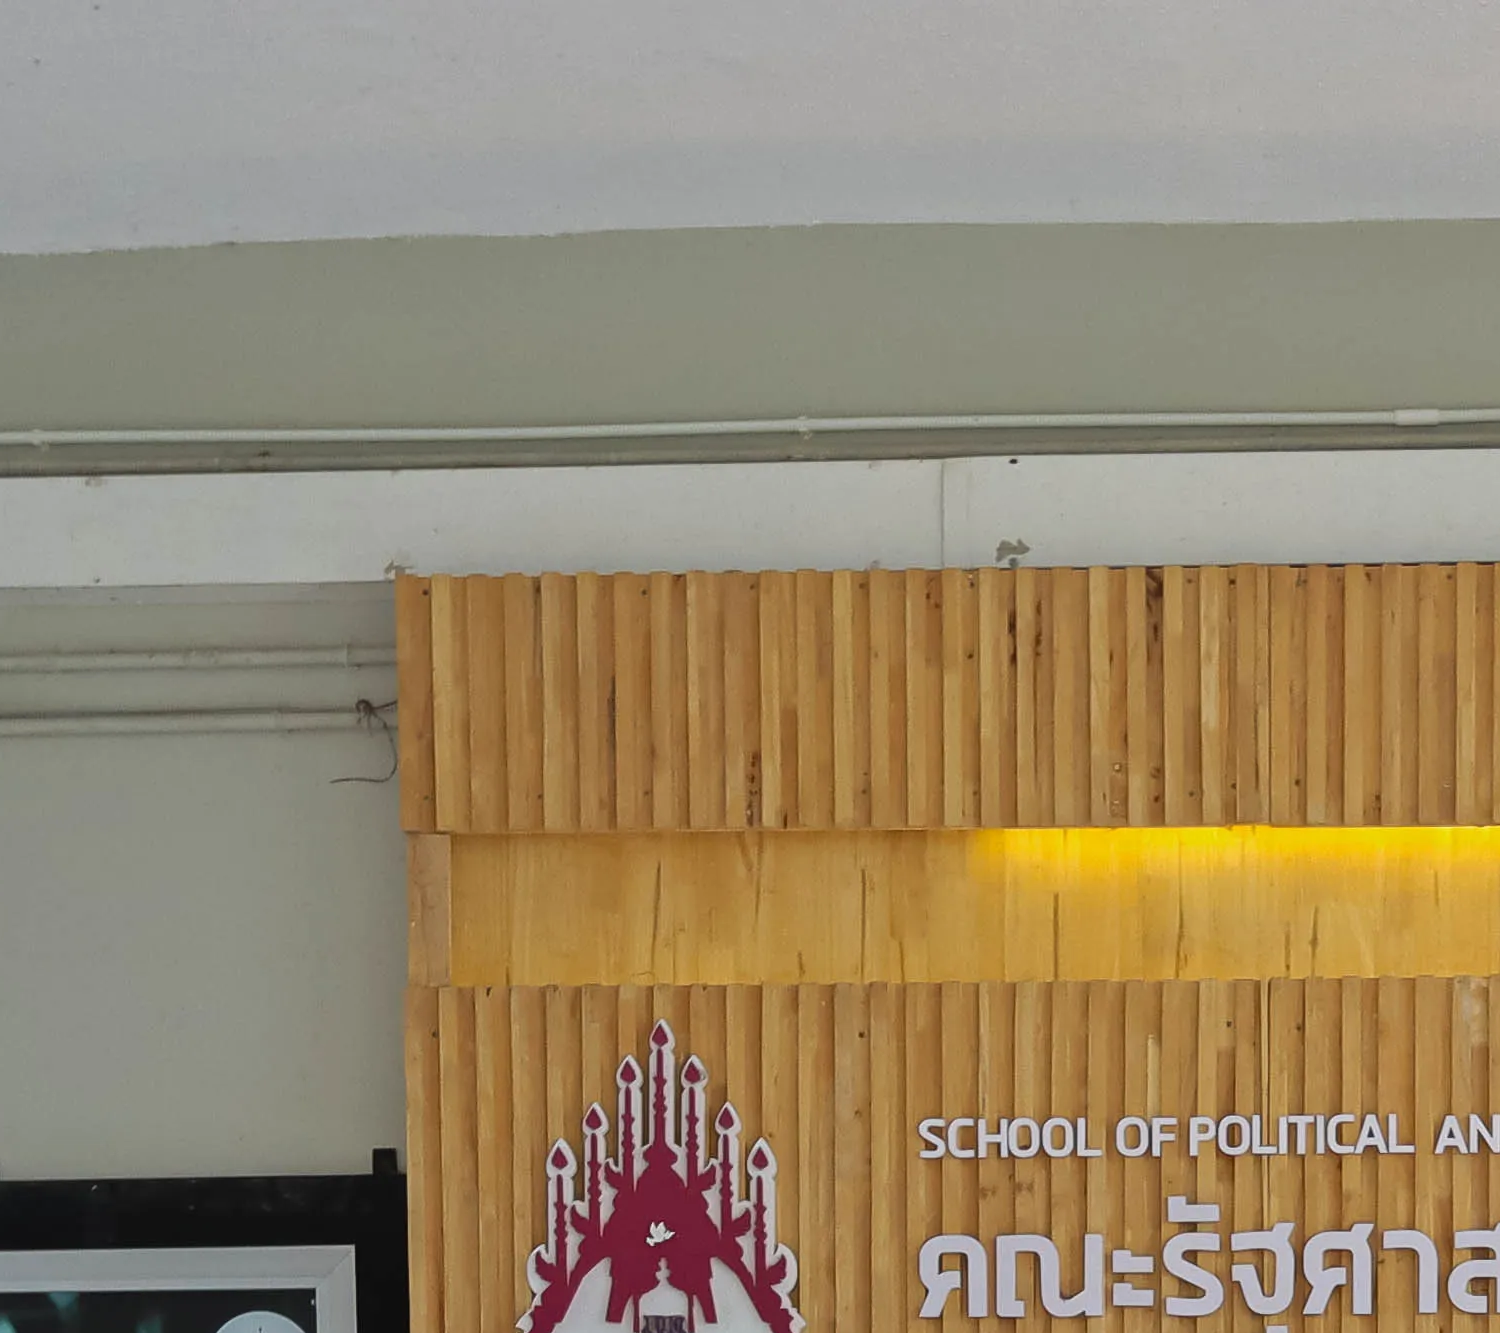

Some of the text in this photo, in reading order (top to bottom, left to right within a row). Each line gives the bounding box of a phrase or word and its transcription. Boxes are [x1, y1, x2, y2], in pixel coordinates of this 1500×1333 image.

[917, 1116, 1104, 1160] SCHOOL
[1114, 1115, 1179, 1158] OF
[1188, 1112, 1416, 1157] POLITICAL
